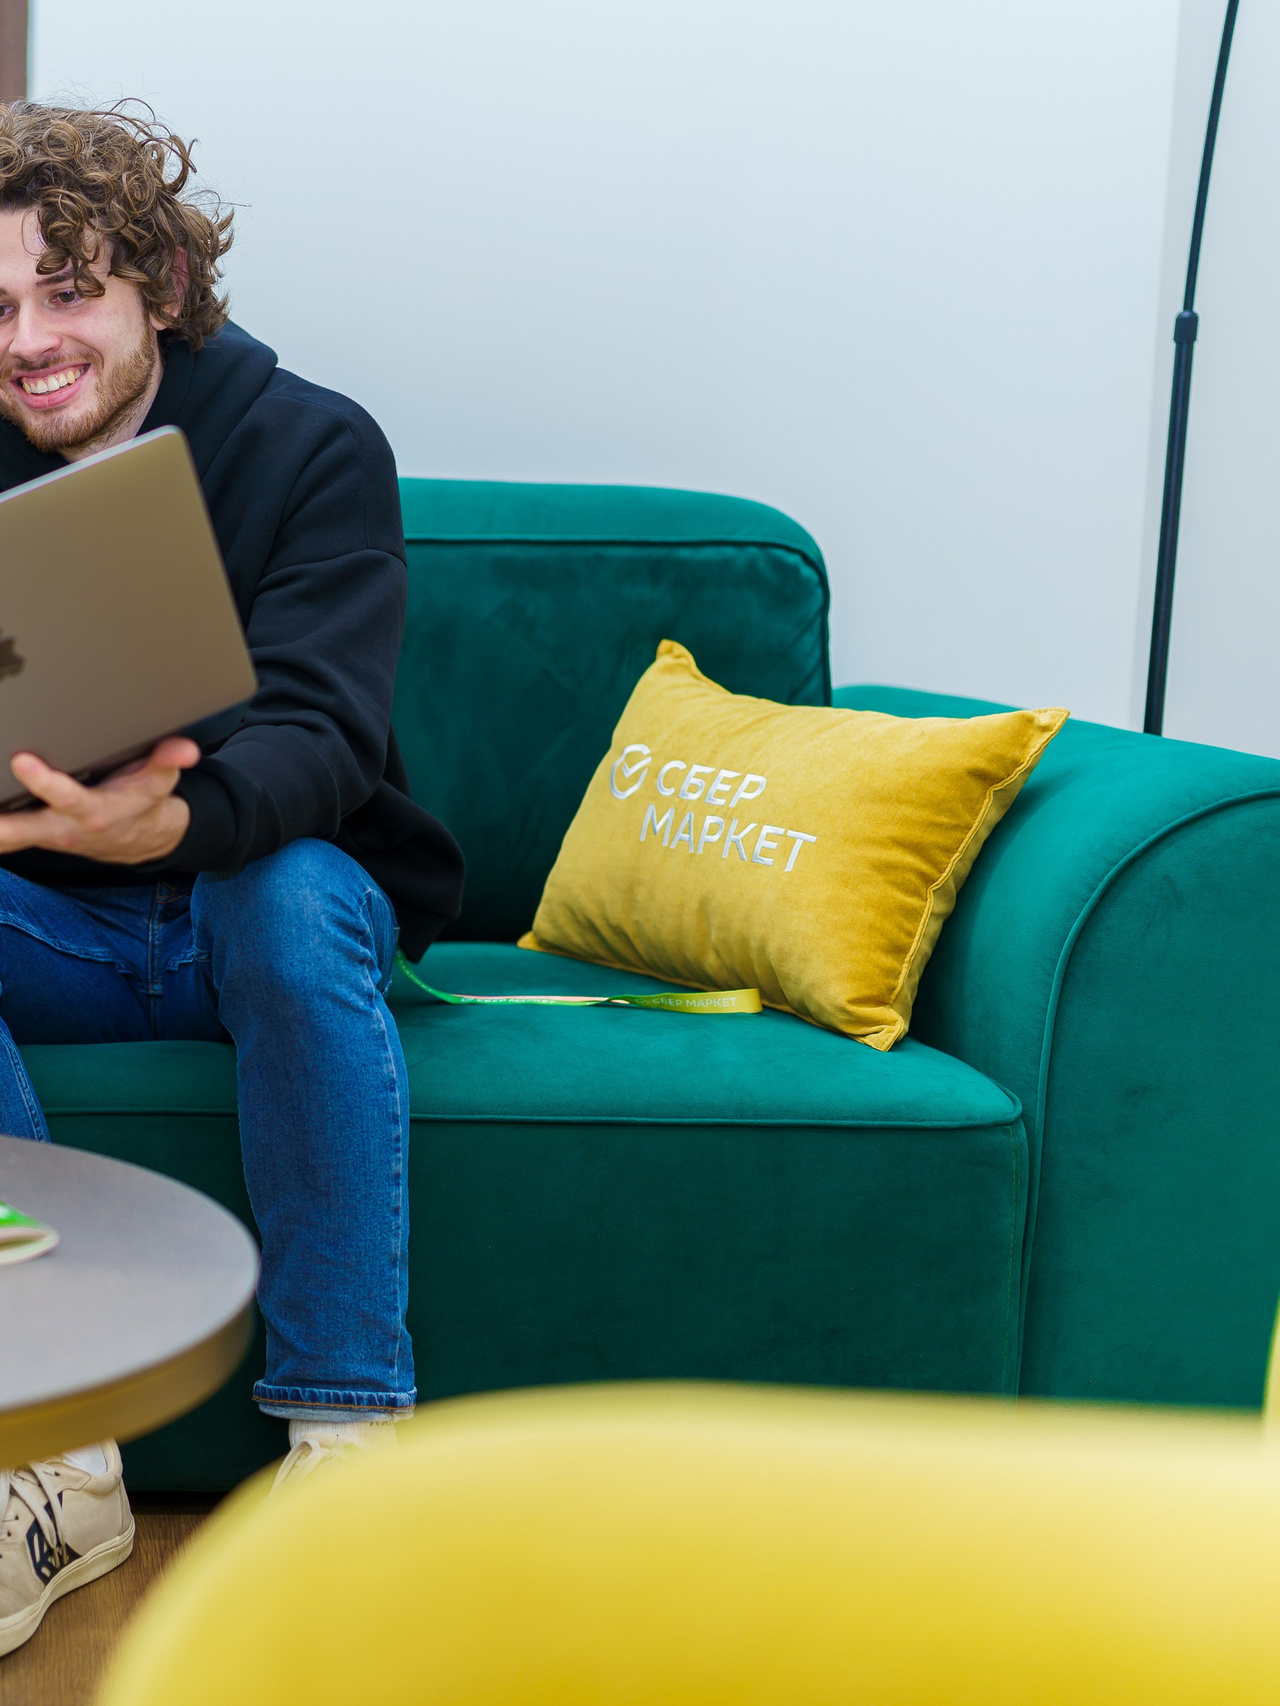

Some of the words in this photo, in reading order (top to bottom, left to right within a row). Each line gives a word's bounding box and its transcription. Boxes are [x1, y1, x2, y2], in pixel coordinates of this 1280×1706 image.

[656, 760, 767, 807] СБЕР
[639, 803, 817, 872] МАРКЕТ
[652, 997, 683, 1007] СБЕР
[685, 997, 738, 1008] МАРКЕТ
